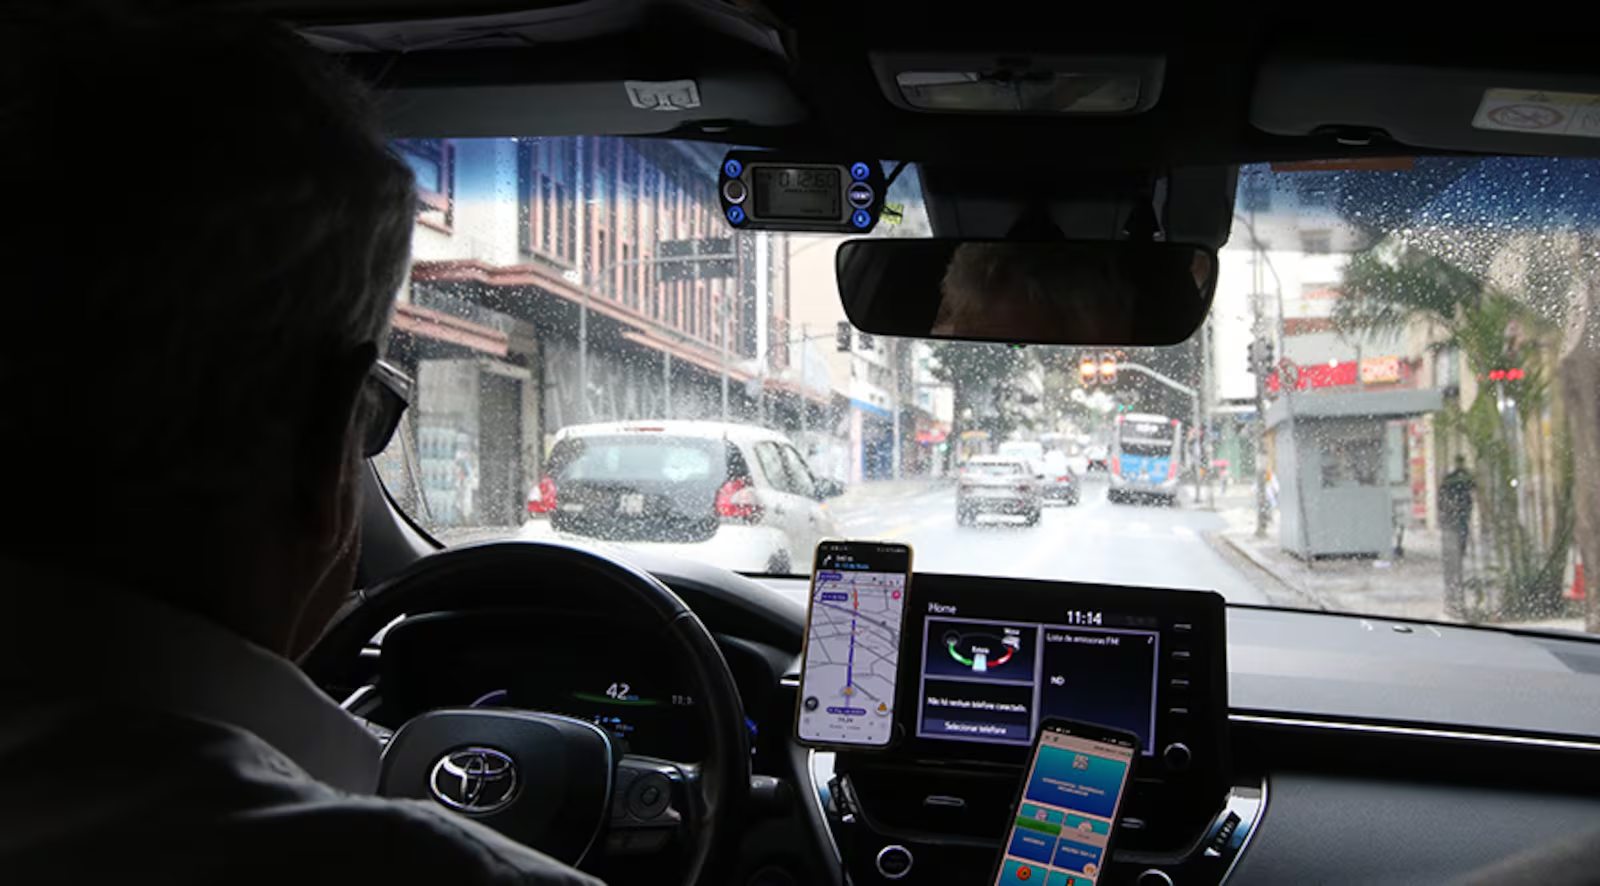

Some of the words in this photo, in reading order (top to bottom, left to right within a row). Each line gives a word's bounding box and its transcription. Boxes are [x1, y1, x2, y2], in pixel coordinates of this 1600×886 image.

[928, 602, 957, 615] Home
[1067, 610, 1102, 625] 11:14
[606, 682, 630, 699] 42
